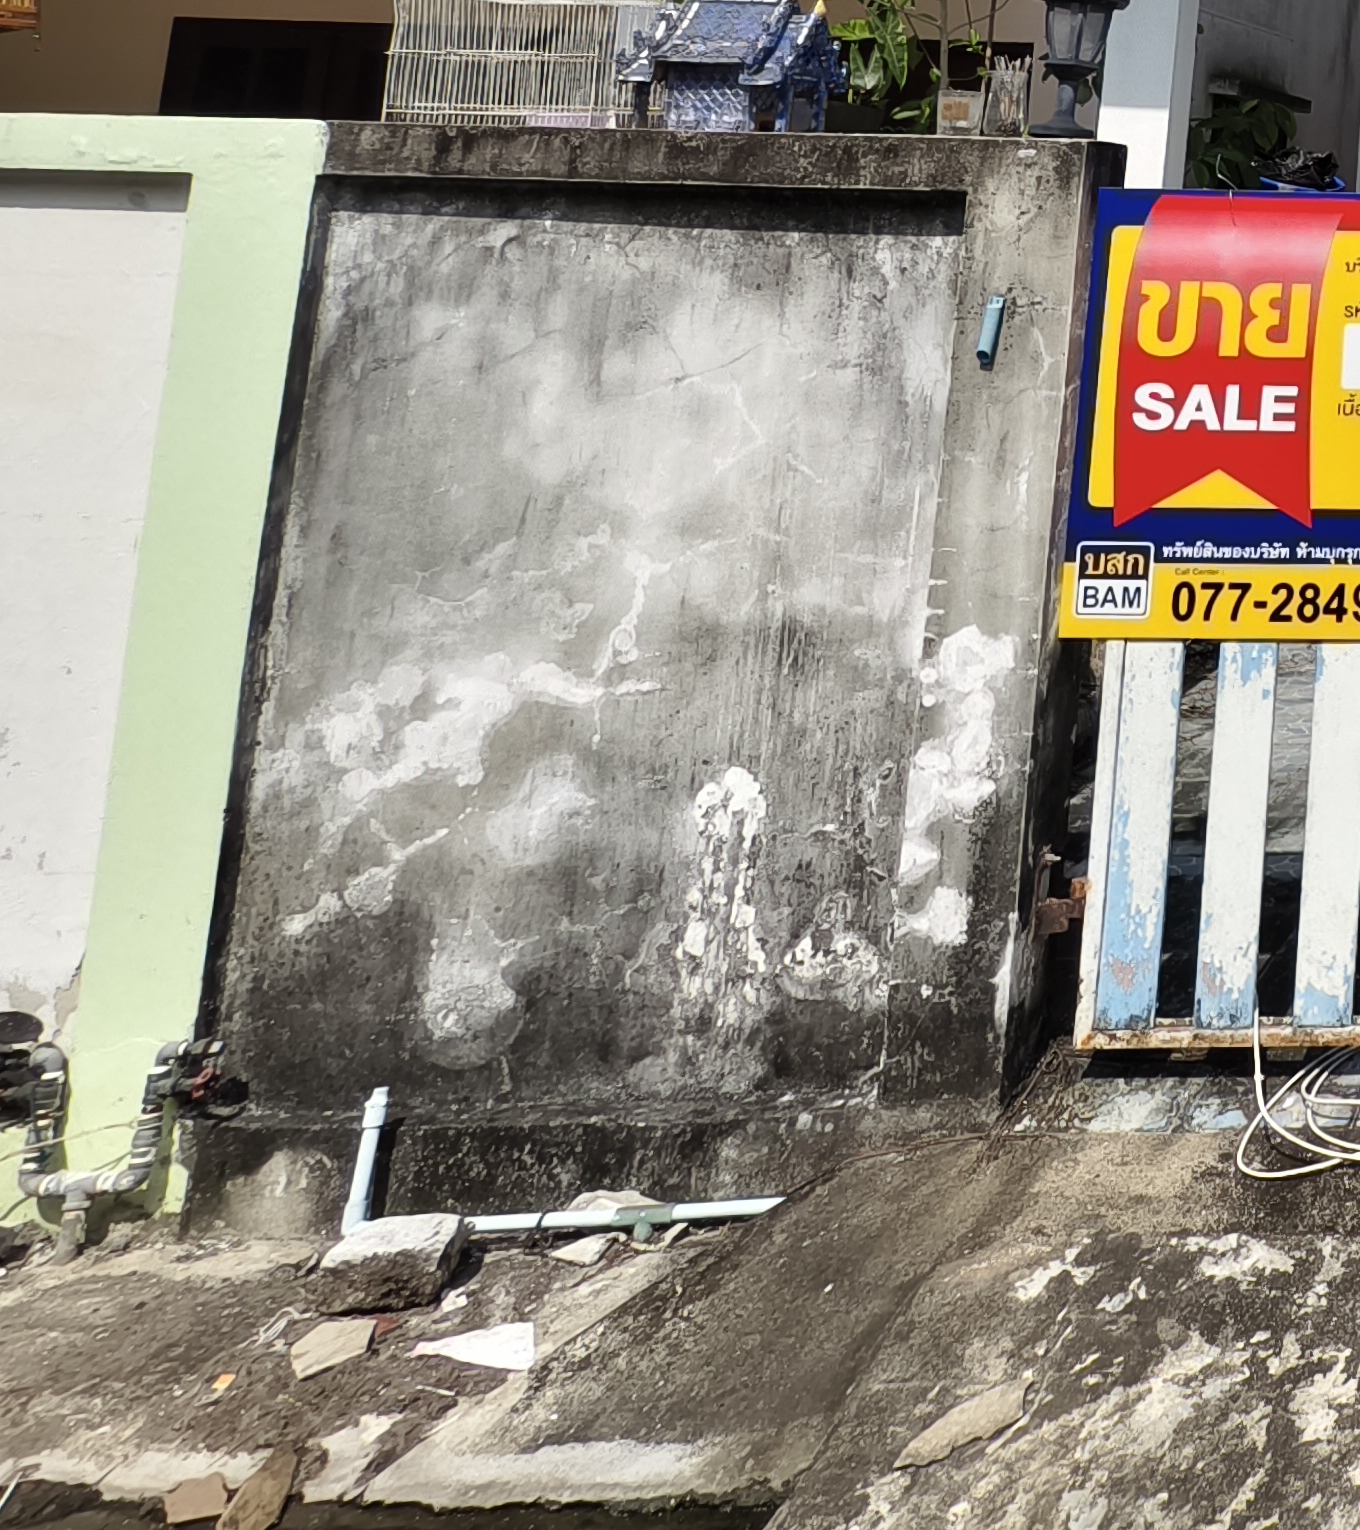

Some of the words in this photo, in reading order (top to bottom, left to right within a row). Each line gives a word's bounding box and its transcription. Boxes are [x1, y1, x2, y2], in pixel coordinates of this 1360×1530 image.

[1136, 279, 1313, 359] ขาย
[1131, 381, 1299, 432] SALE
[1084, 550, 1145, 576] บสก
[1162, 540, 1290, 560] ทรัพย์สินของบริษัท
[1082, 585, 1142, 609] BAM
